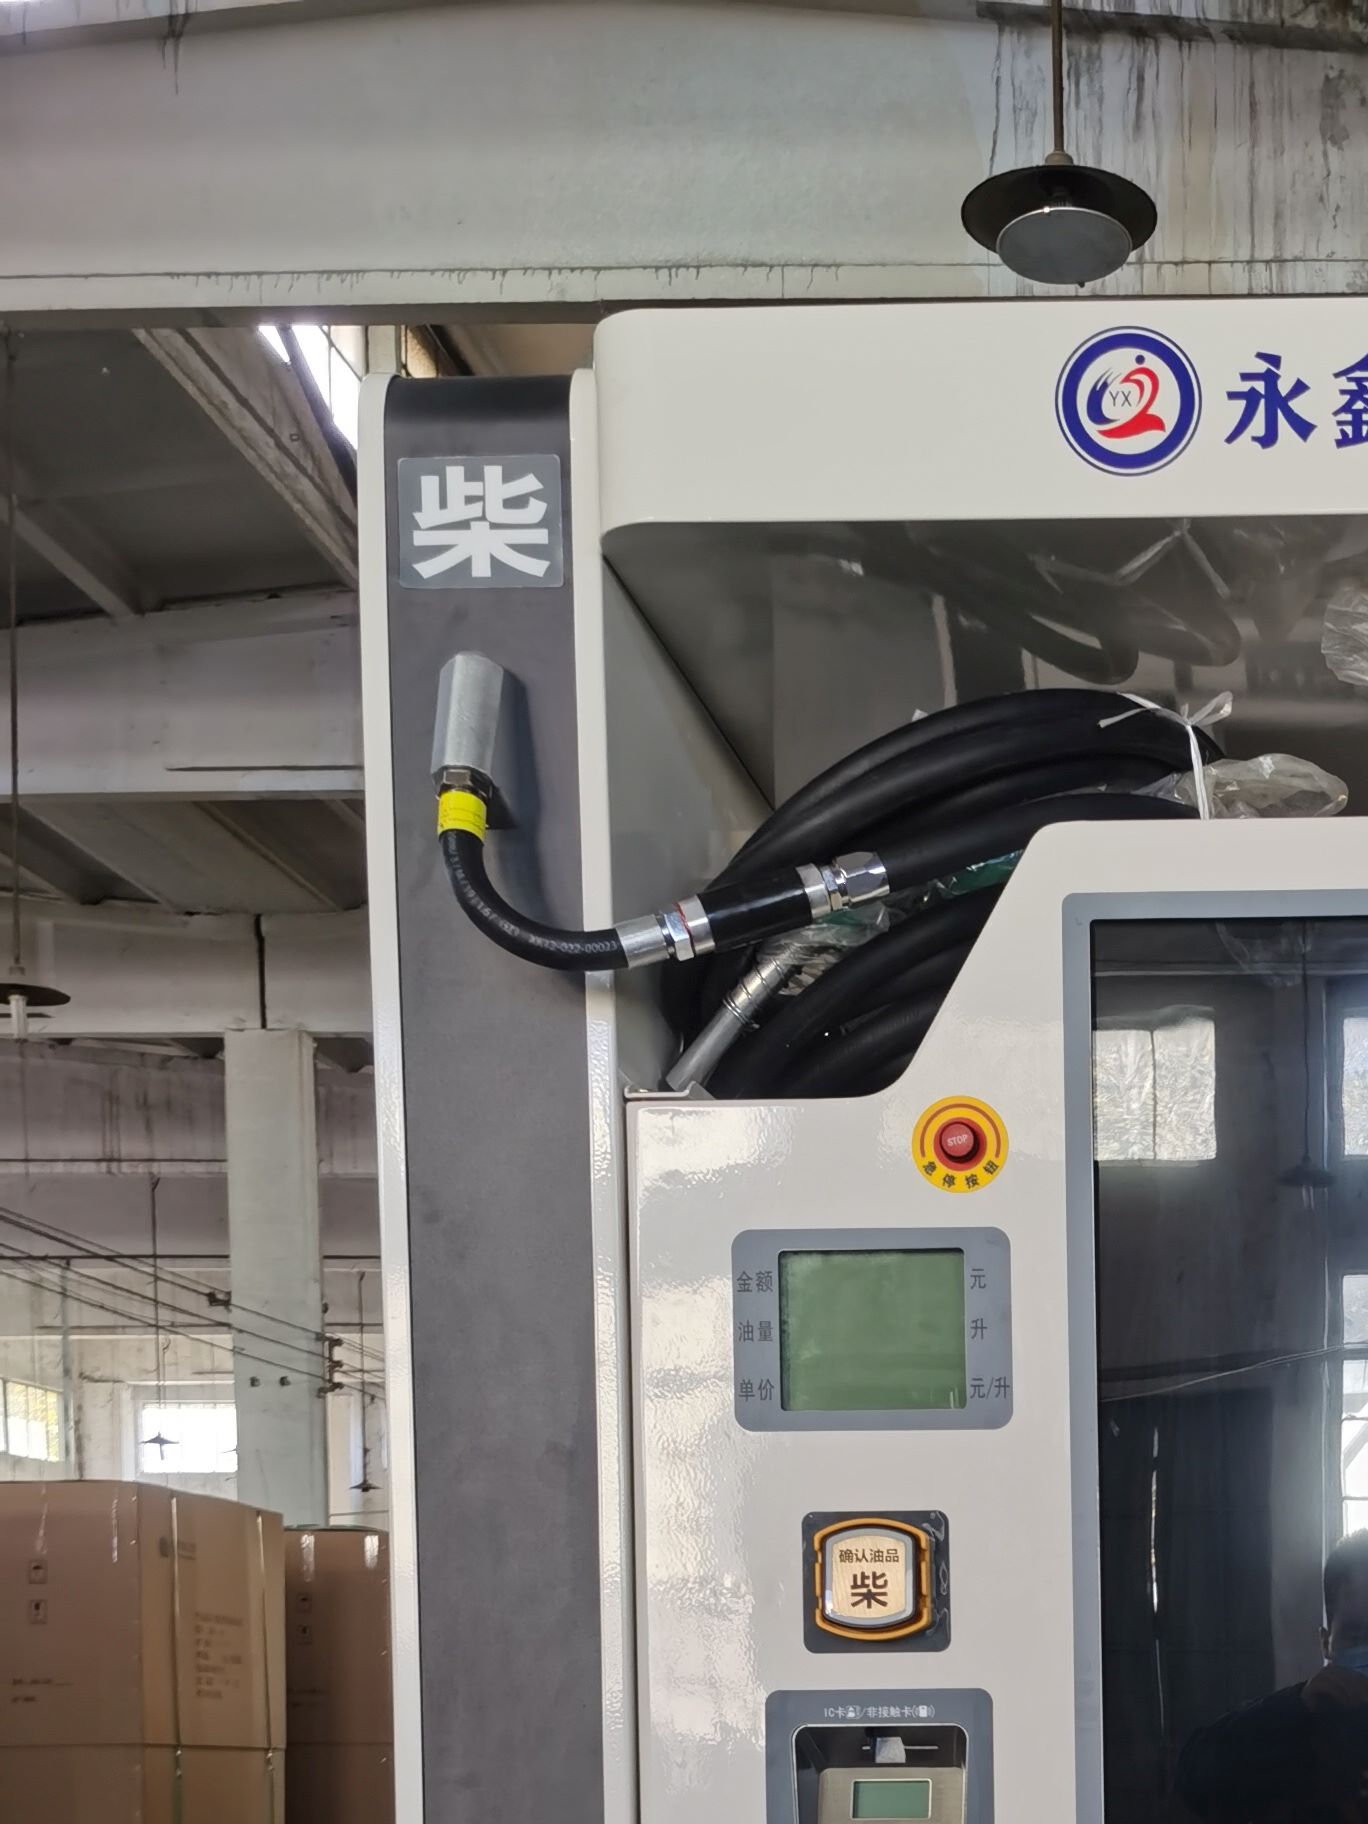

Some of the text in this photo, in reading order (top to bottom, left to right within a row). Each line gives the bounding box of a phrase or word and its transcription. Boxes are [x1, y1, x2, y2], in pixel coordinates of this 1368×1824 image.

[1108, 390, 1132, 408] YX
[411, 465, 550, 579] 柴
[946, 1133, 969, 1147] STOP
[736, 1270, 774, 1294] 金额
[970, 1268, 987, 1290] 元
[738, 1320, 774, 1343] 油量
[970, 1317, 988, 1341] 升
[738, 1378, 775, 1402] 单价
[970, 1375, 1011, 1400] 元/升
[838, 1548, 900, 1564] 确认油品
[850, 1571, 889, 1609] 柴
